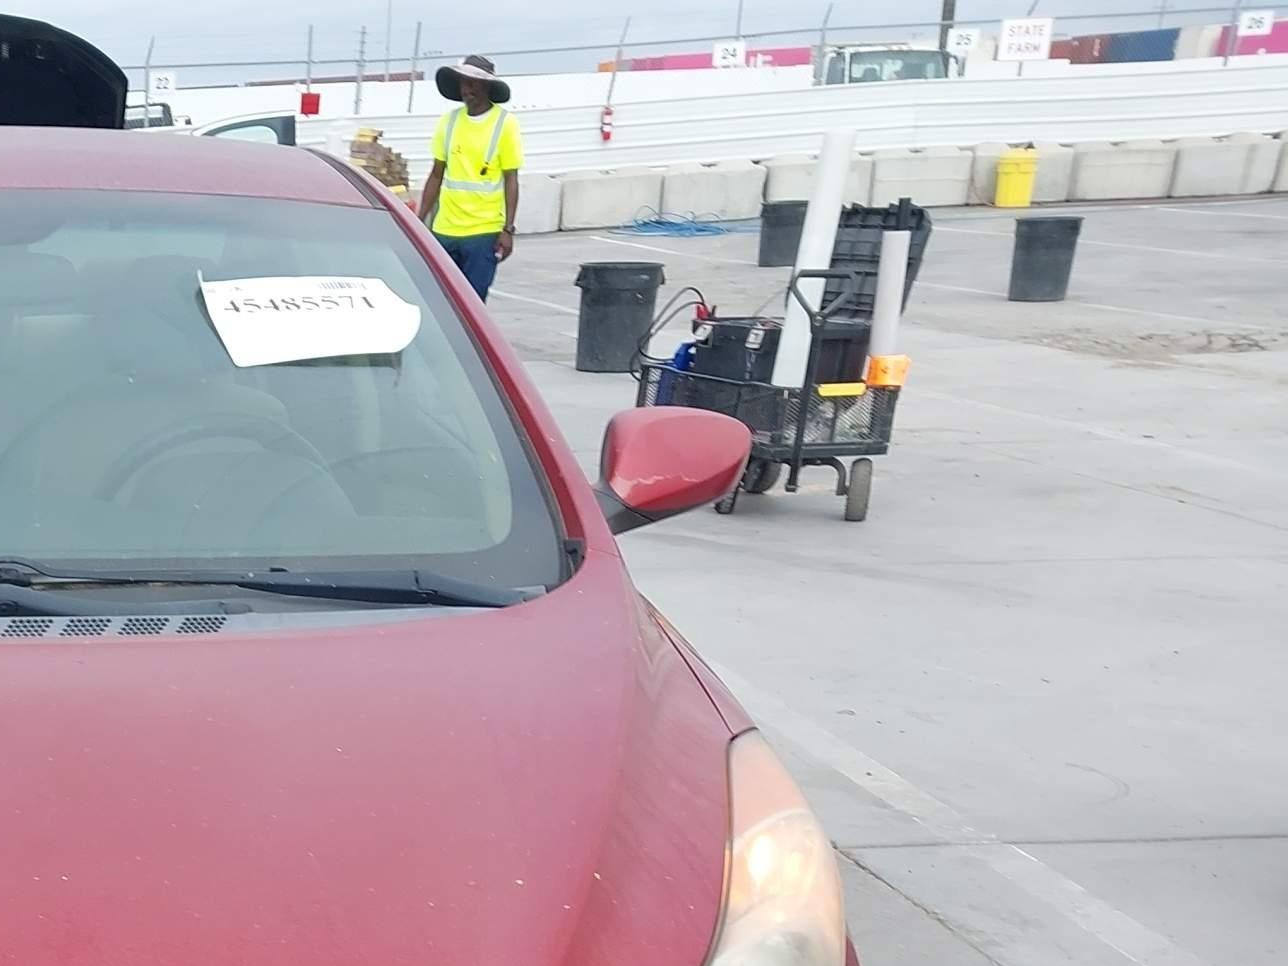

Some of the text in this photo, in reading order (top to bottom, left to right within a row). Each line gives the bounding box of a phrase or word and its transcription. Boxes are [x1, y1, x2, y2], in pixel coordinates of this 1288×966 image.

[1008, 24, 1046, 37] STATE
[1007, 42, 1041, 54] FARM
[223, 295, 376, 313] 45485571
